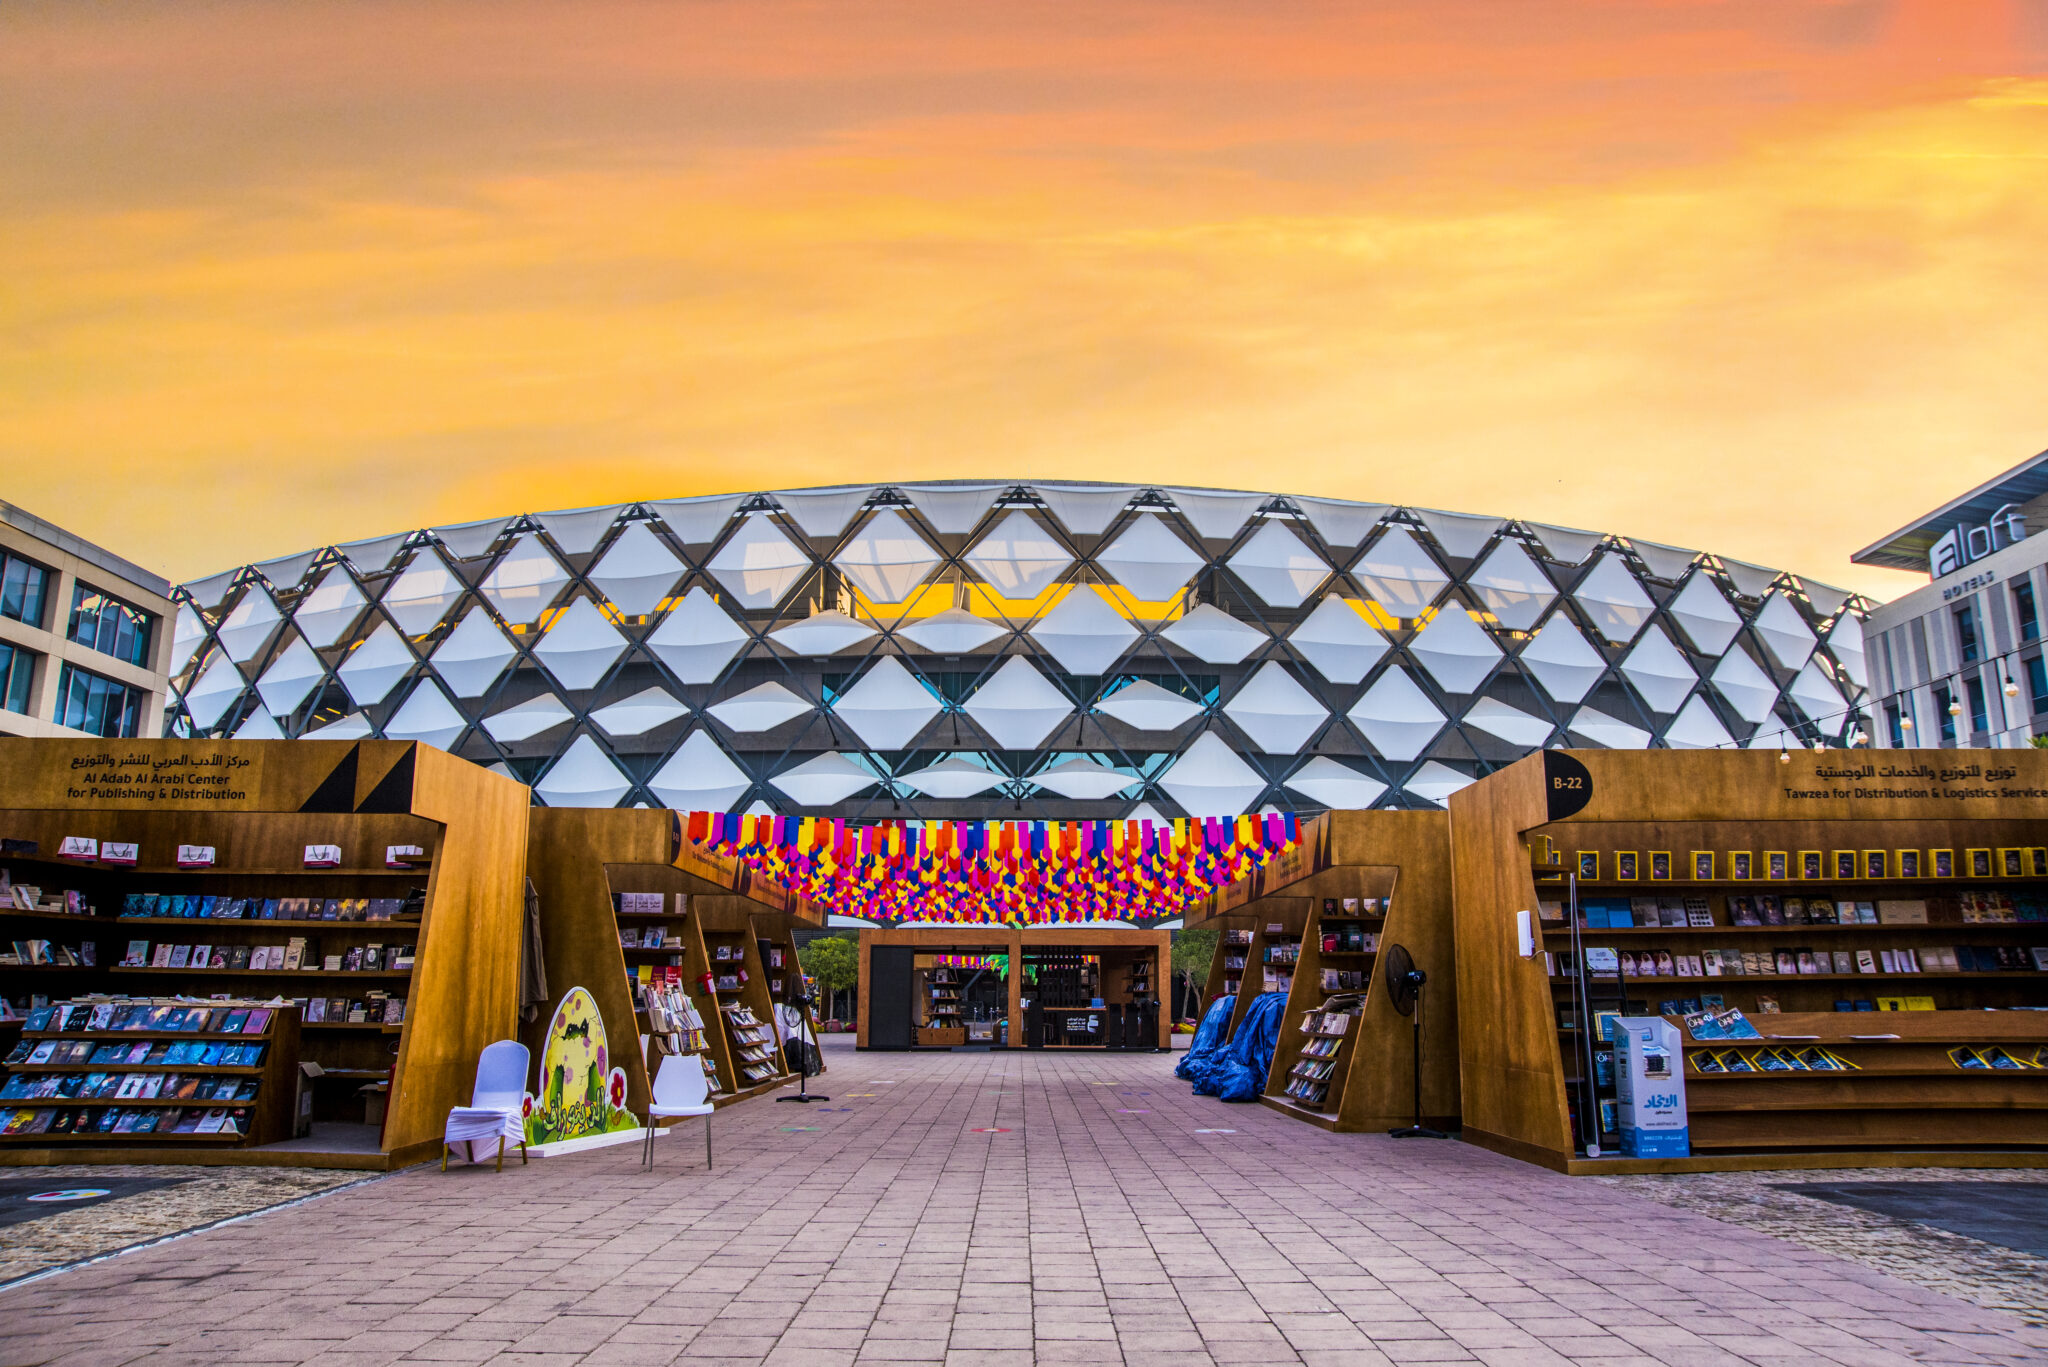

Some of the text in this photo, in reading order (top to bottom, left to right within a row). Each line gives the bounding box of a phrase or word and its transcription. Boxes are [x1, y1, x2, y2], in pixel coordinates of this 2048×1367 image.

[1929, 503, 2028, 580] aloft
[1943, 570, 1994, 600] HOTELS
[70, 752, 250, 771] مركز الأدب العربي للنشر والتوزيع
[83, 773, 230, 785] Al Adab Al Arabi Center
[1815, 764, 2017, 782] توزيع للتوزيع والخدمات اللوجستية
[1553, 776, 1583, 789] B-22
[67, 787, 246, 801] for Publishing & Distribution
[1784, 788, 1829, 799] Tawzea
[1832, 788, 1851, 798] for
[1855, 788, 1928, 798] Distribution
[1931, 787, 1940, 798] &
[1943, 787, 1998, 800] Logistics
